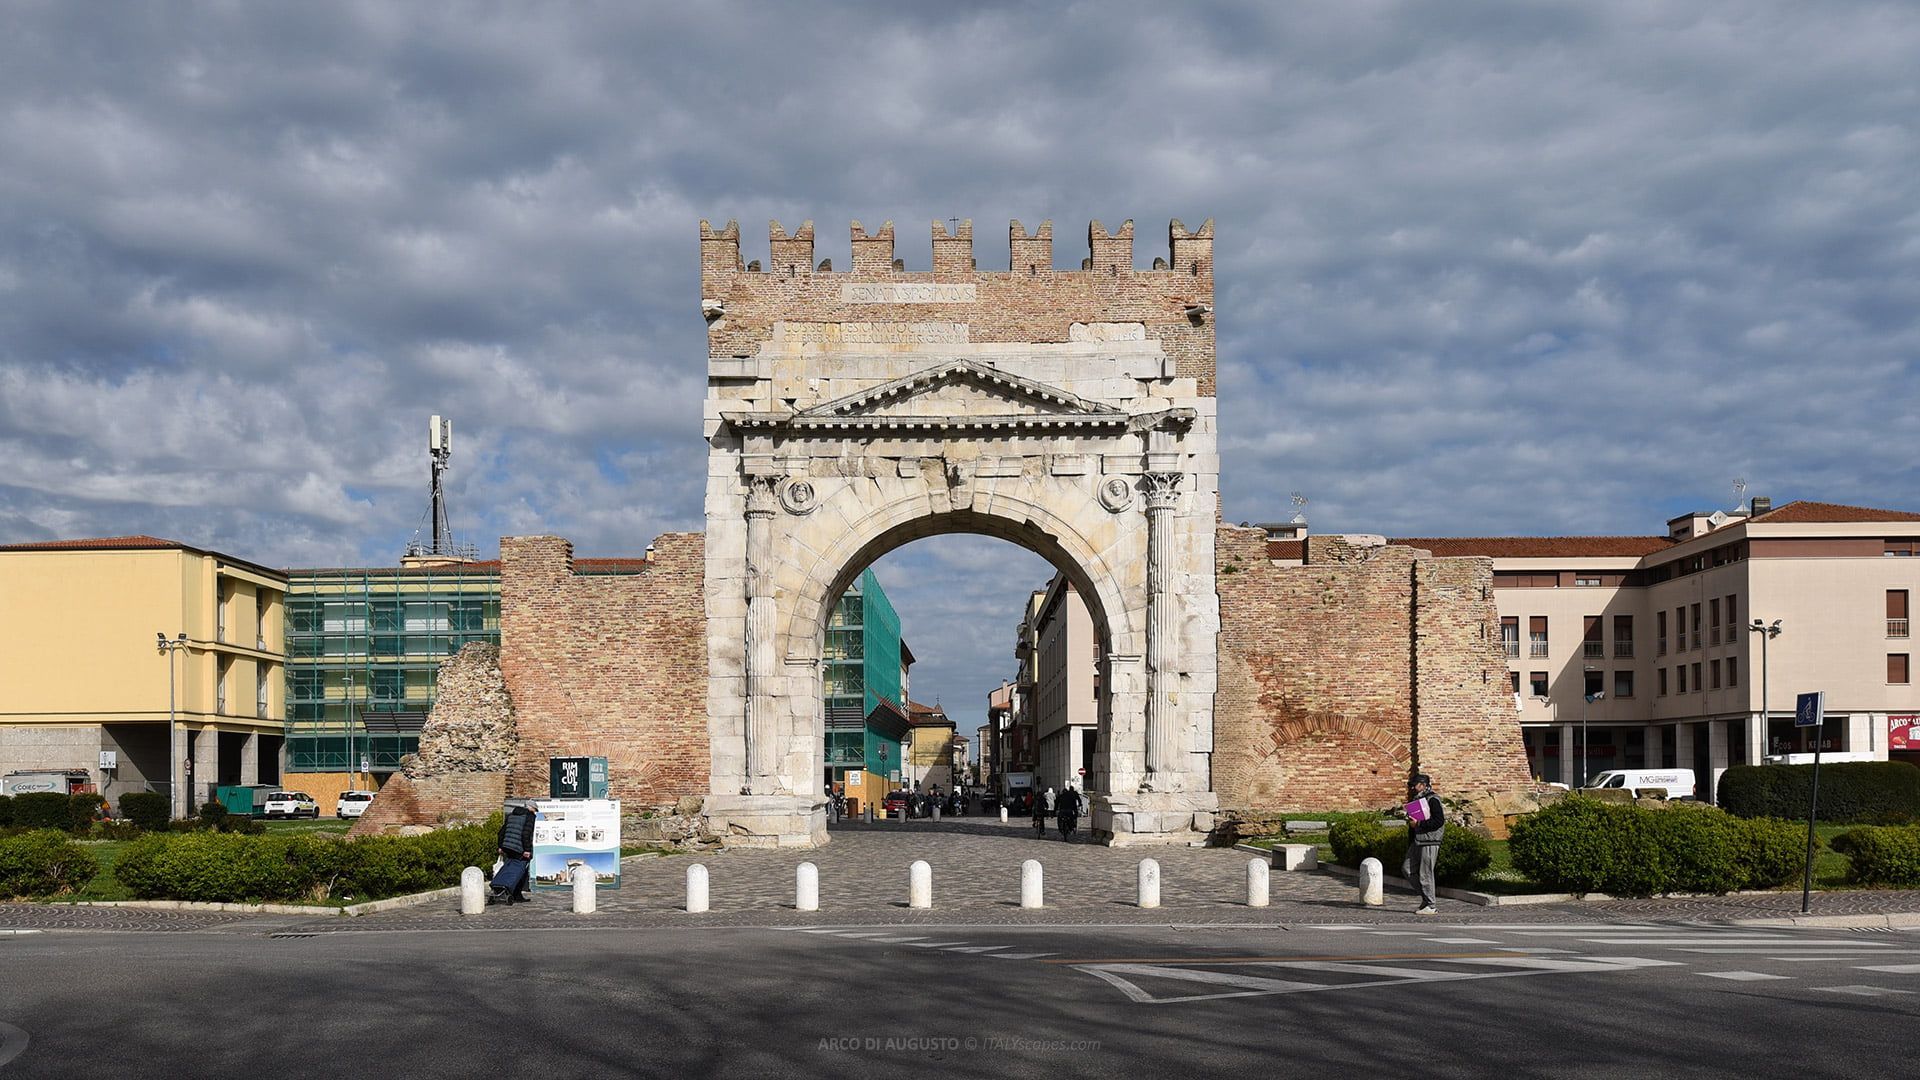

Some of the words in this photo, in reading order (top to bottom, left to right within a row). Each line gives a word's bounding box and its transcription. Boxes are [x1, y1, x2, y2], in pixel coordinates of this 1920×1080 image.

[1890, 718, 1908, 732] ARCO
[1808, 740, 1832, 750] KEAB
[562, 762, 578, 771] RIM
[1639, 775, 1655, 784] MG
